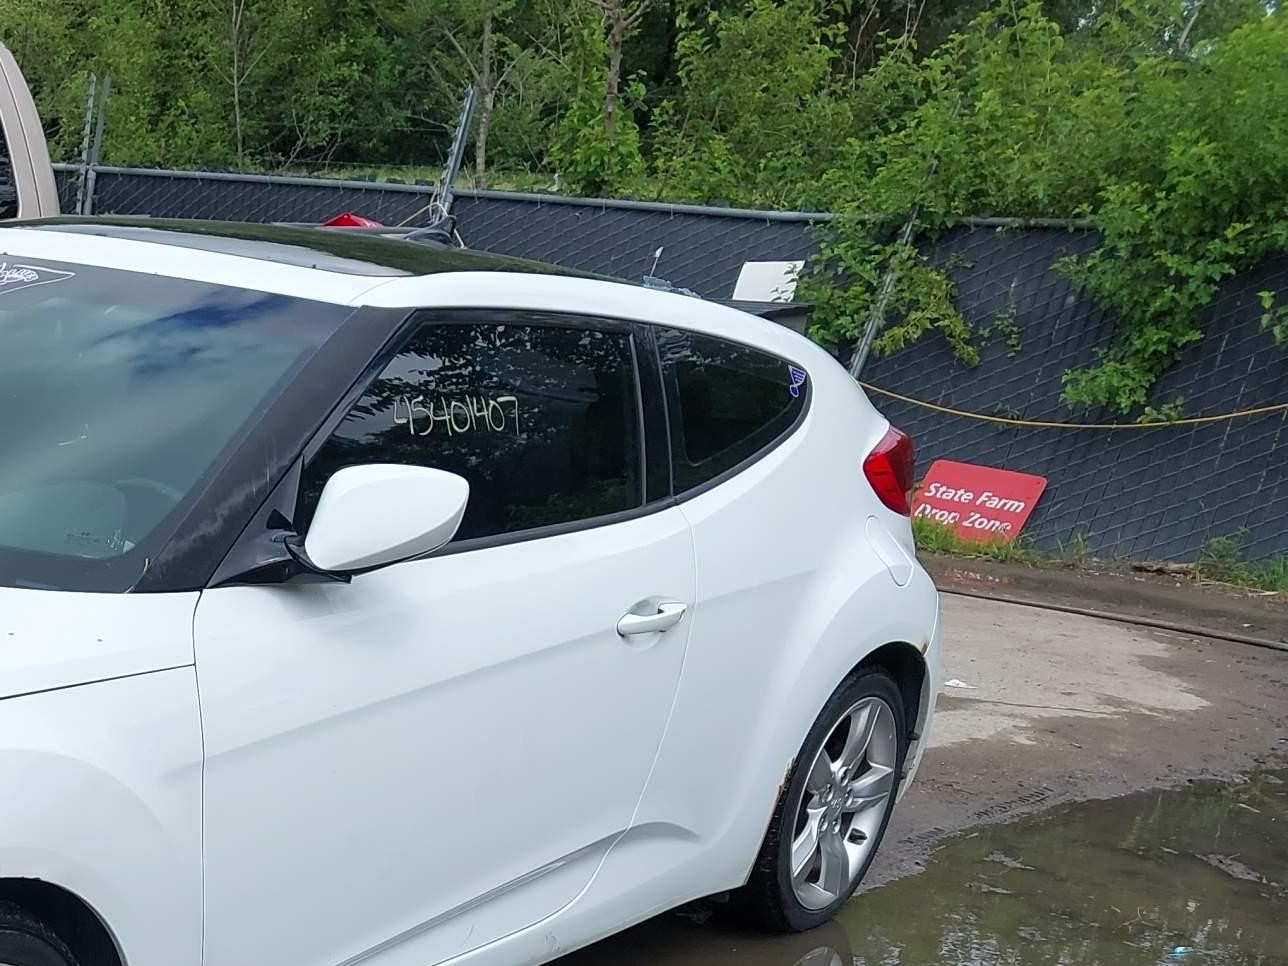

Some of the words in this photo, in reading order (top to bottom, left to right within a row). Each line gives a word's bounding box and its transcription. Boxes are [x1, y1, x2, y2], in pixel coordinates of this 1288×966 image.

[393, 394, 520, 437] 45401407
[924, 483, 974, 503] State
[975, 492, 1025, 513] Farm
